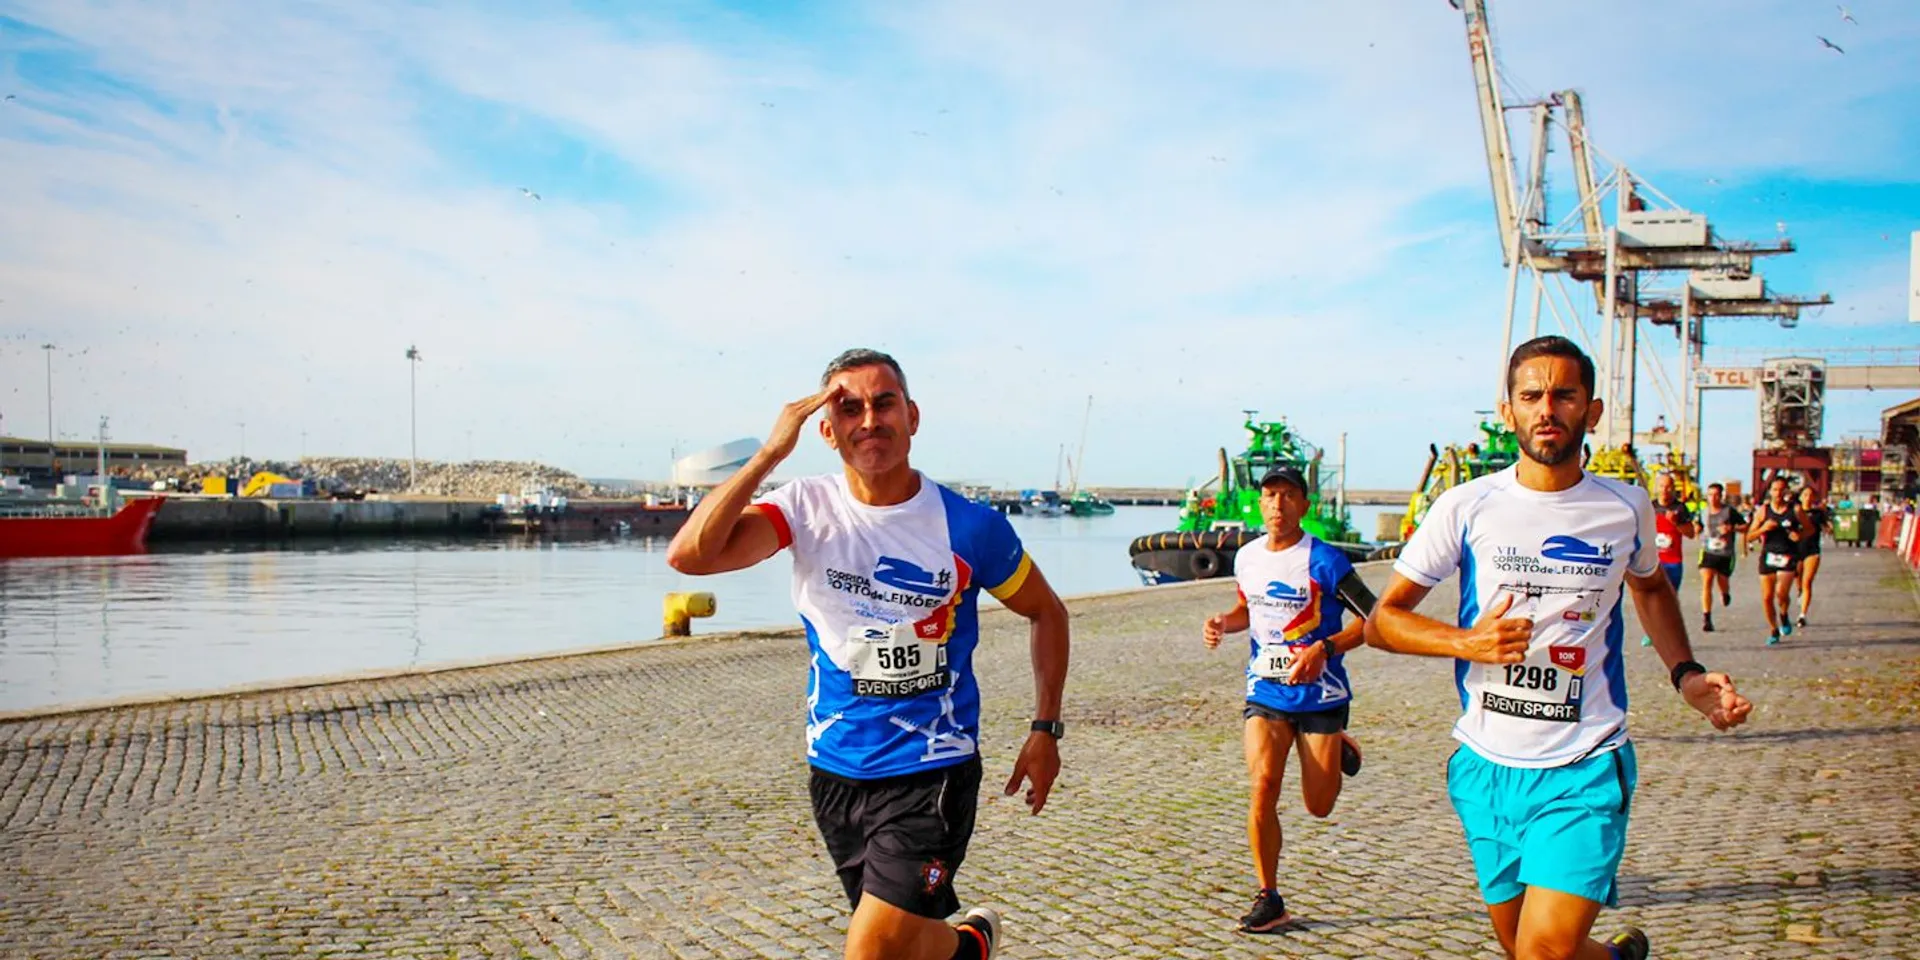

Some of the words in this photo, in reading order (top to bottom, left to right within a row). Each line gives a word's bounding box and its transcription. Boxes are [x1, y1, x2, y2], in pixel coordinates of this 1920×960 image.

[1714, 371, 1749, 384] TCL
[1492, 555, 1540, 564] CORRIDA
[826, 567, 871, 587] CORRIDA
[922, 622, 939, 632] 10K
[877, 643, 921, 669] 585
[1558, 652, 1576, 661] 10K
[857, 672, 944, 695] EVENTSPORT
[1503, 664, 1558, 691] 1298
[1485, 694, 1574, 717] EVENTSPORT
